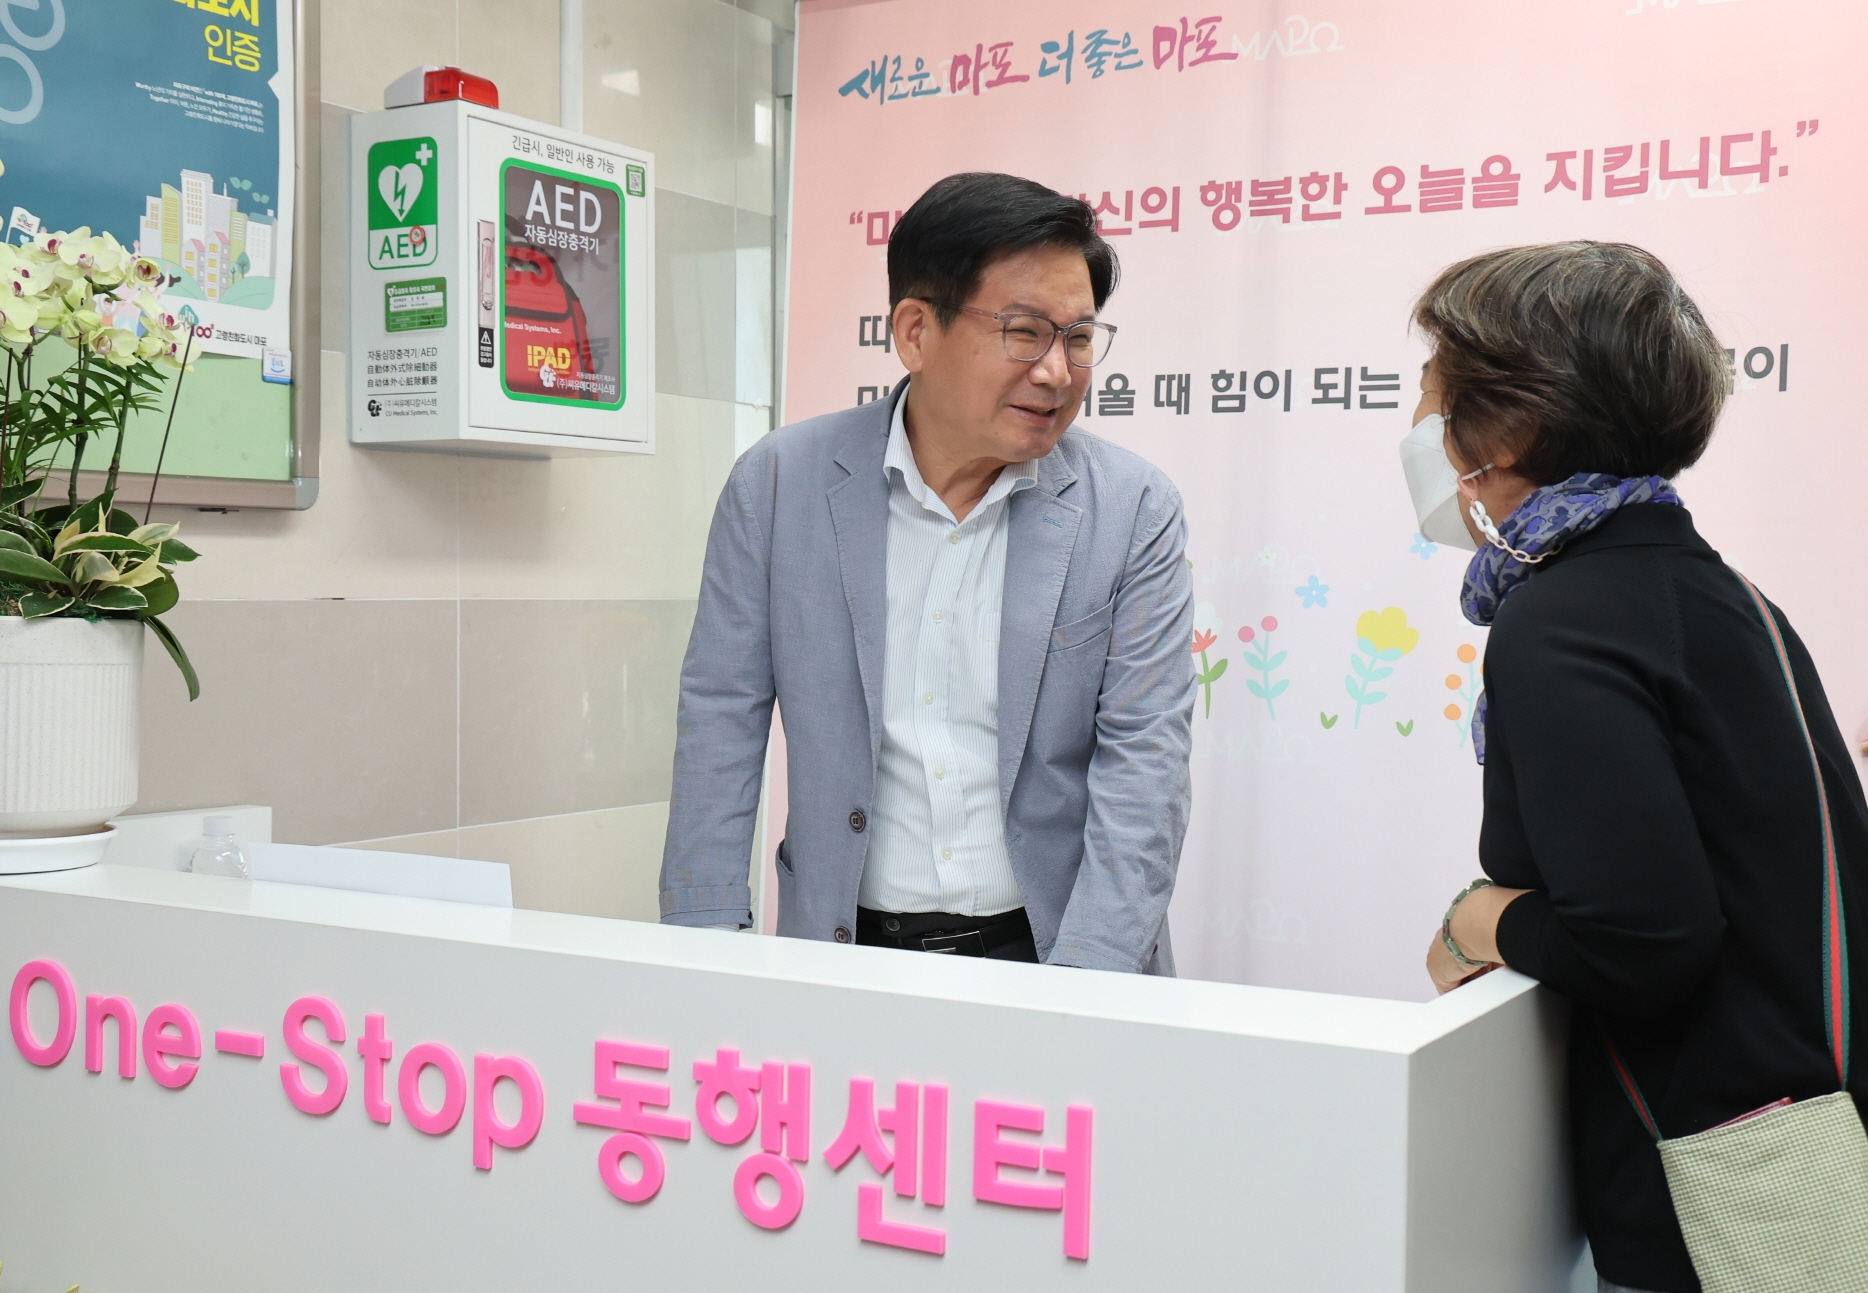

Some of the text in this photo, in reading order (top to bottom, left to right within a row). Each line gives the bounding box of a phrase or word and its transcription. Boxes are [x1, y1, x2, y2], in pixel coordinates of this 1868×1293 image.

[204, 24, 262, 72] 인증
[838, 16, 1238, 105] 새로운 마포 더 좋은 마포
[511, 135, 615, 175] 긴급시, 일반인 사용 가능
[1062, 186, 1181, 238] 신의
[1199, 171, 1348, 233] 행복한
[1365, 154, 1521, 214] 오늘을
[1544, 119, 1819, 201] 지킵니다.”
[525, 180, 602, 234] AED
[378, 232, 428, 261] AED
[524, 224, 600, 256] 자동심장충격기
[215, 329, 268, 347] 고령친화도시 마포
[526, 344, 571, 370] IPAD
[1154, 373, 1192, 415] 때
[1210, 369, 1293, 413] 힘이
[1311, 366, 1400, 410] 되는
[7, 958, 1094, 1260] One-Stop 동행센터
